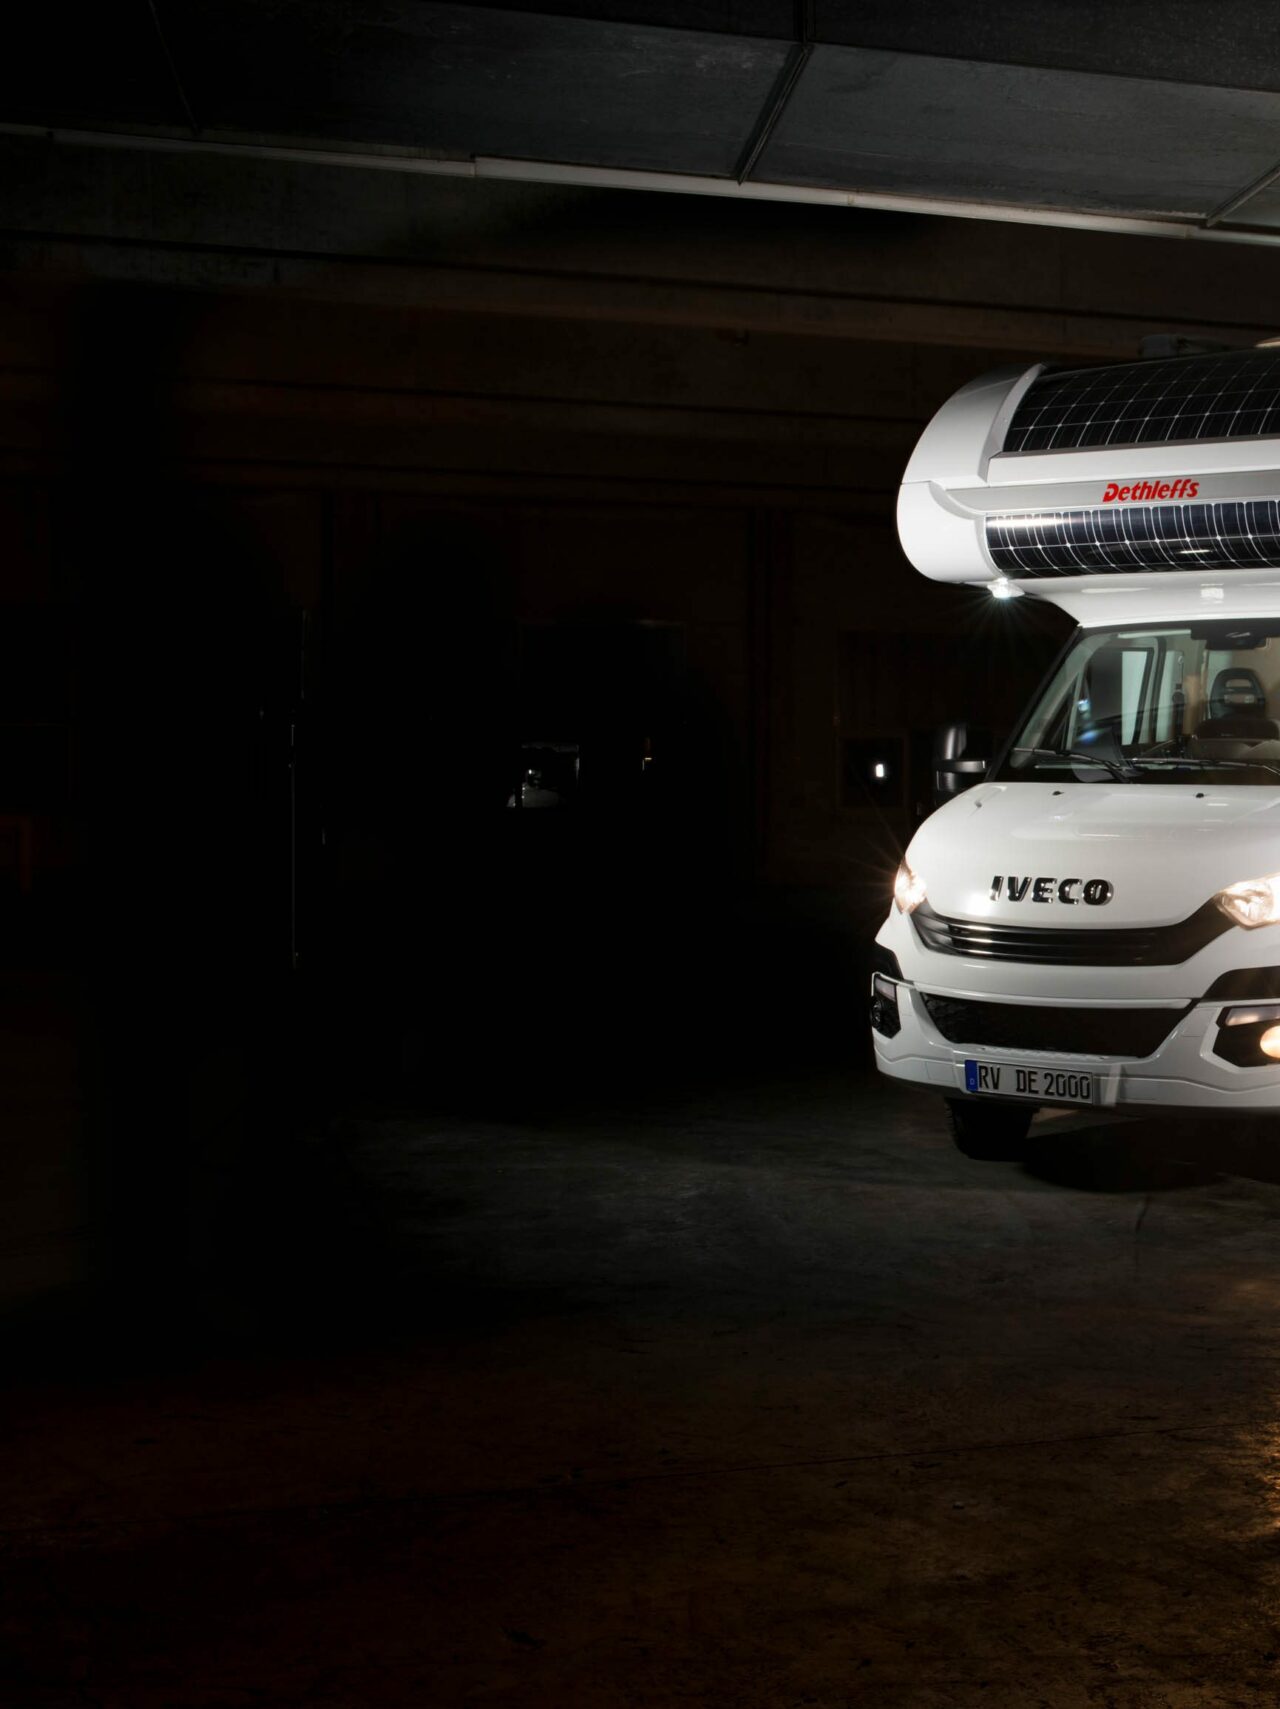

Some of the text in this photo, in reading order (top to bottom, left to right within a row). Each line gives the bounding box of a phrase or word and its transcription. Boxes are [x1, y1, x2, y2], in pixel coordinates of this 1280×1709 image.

[1102, 478, 1199, 502] Dethleffs
[990, 875, 1114, 906] IVECO
[978, 1065, 1091, 1100] RV DE 2000
